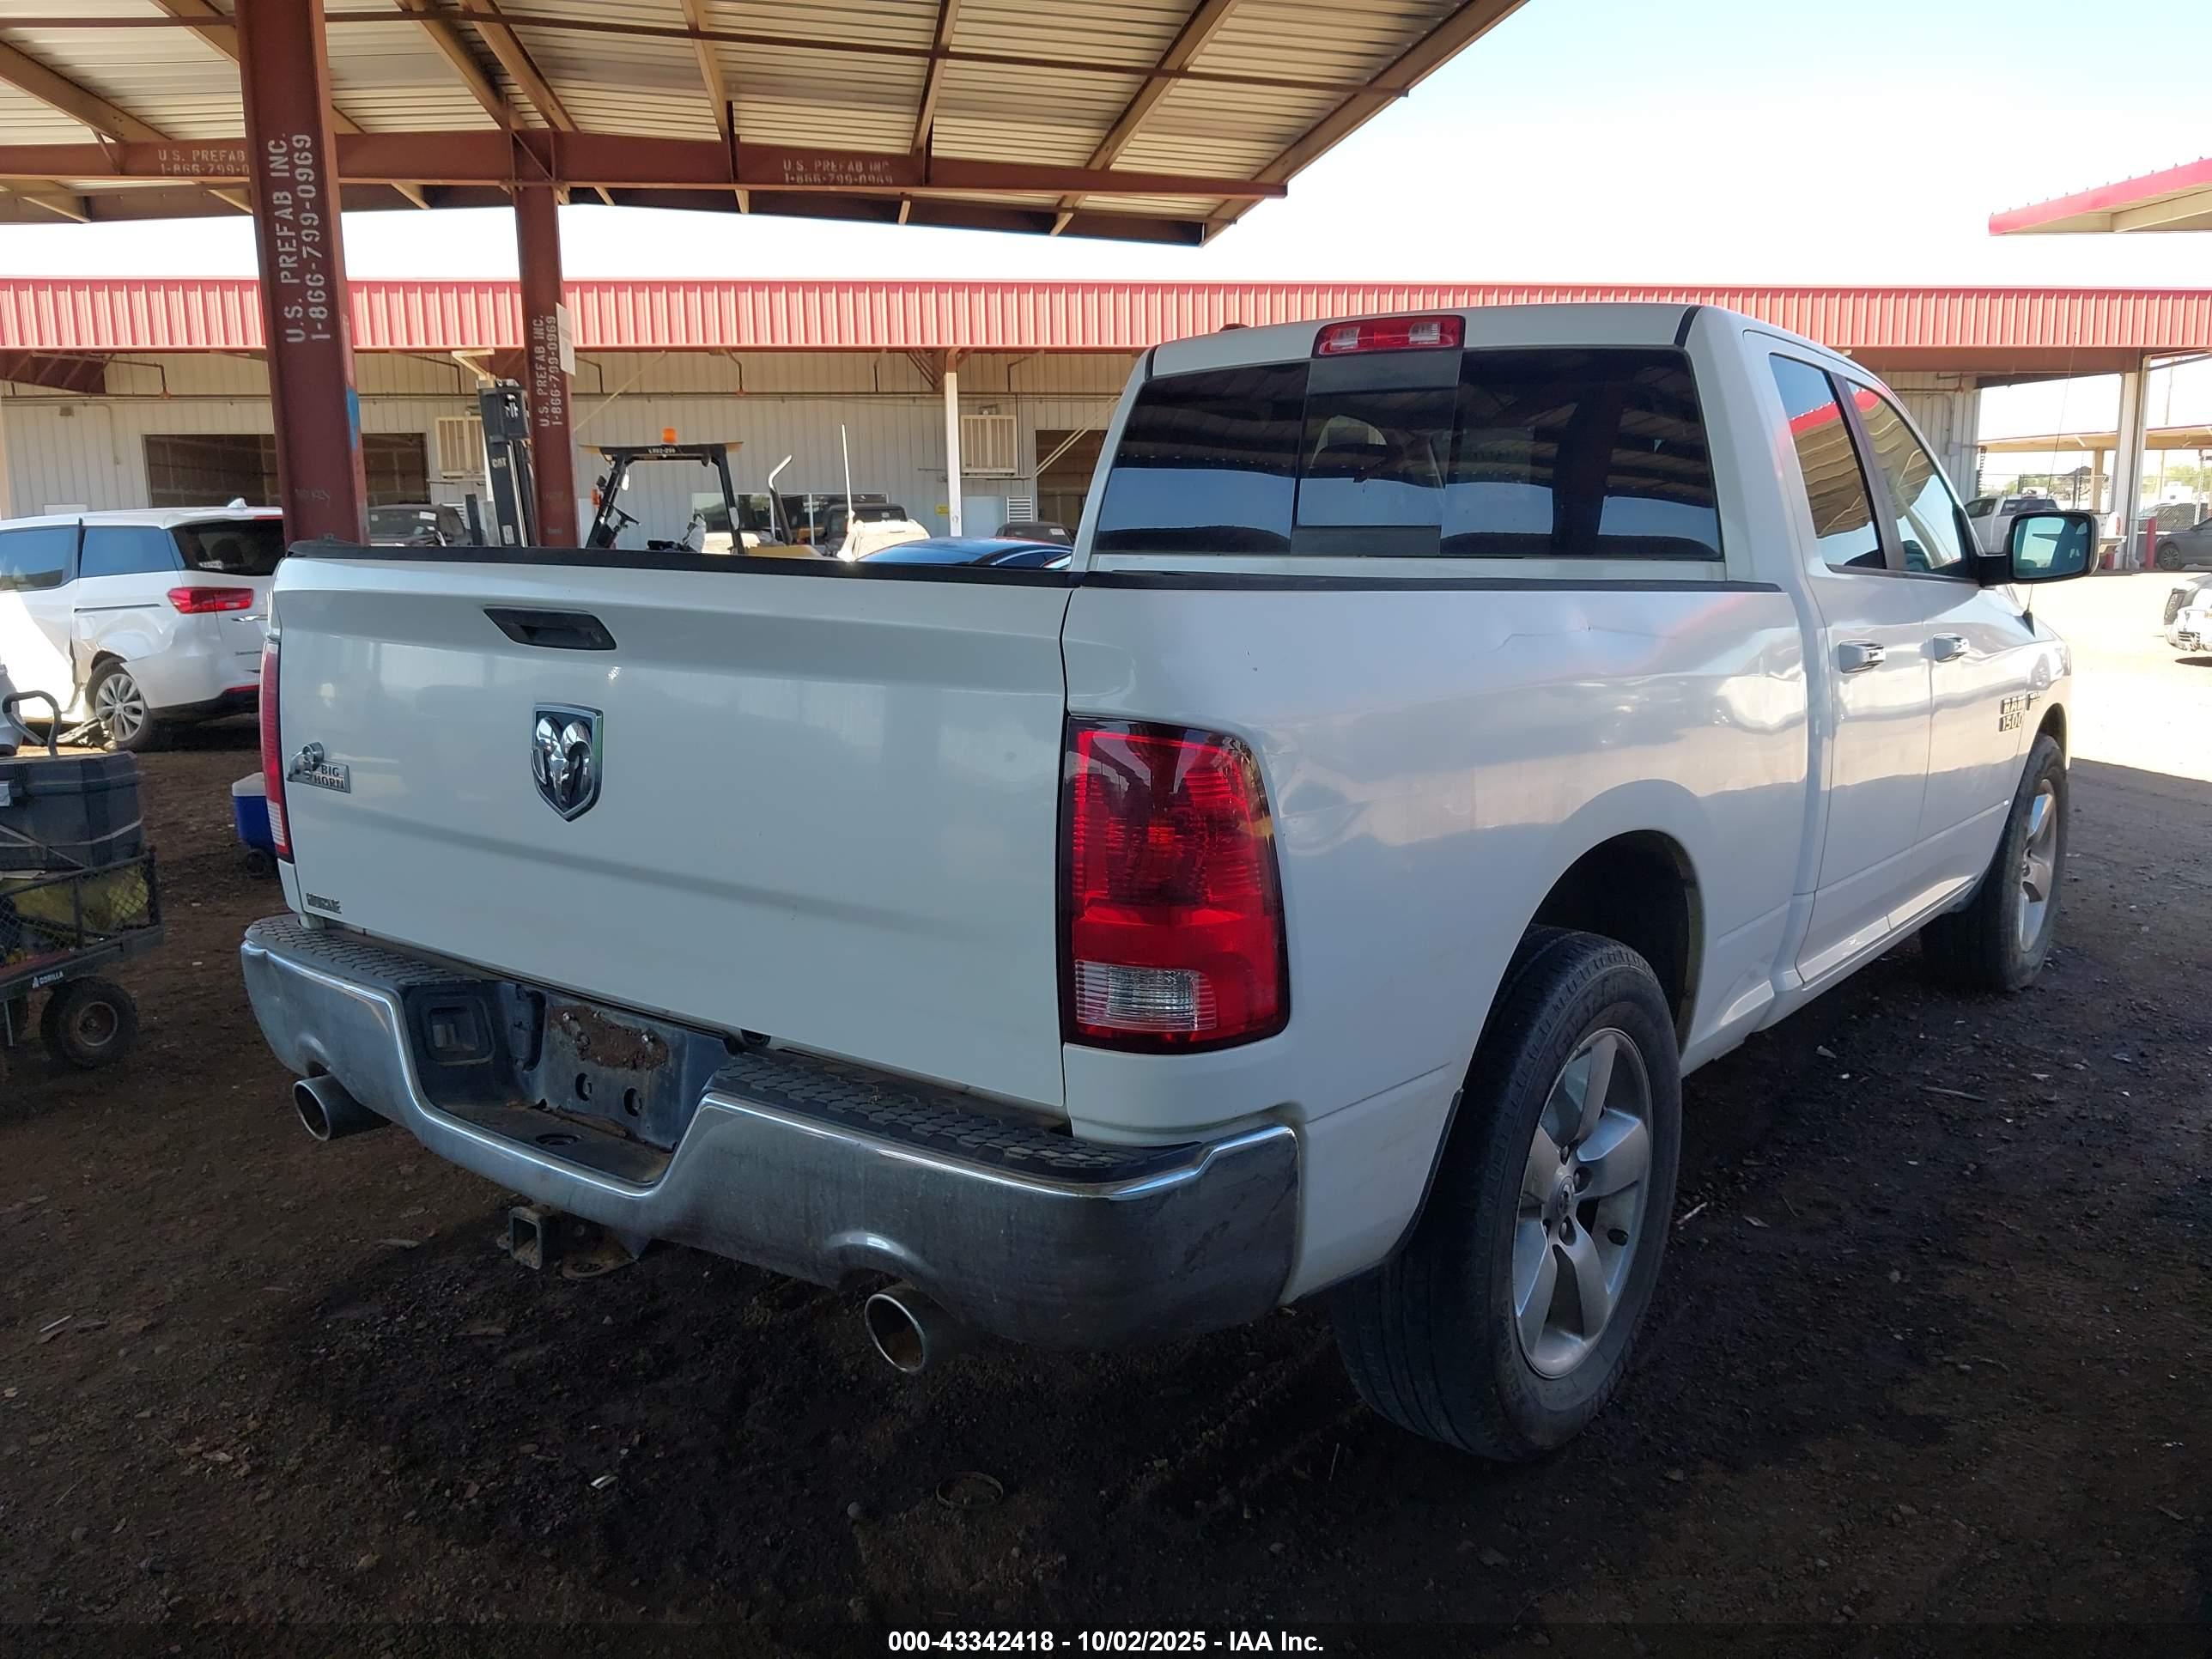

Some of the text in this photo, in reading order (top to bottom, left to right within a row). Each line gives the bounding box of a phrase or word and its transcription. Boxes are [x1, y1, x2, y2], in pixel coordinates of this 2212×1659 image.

[191, 149, 246, 162] PREFAB
[268, 132, 306, 343] U.S. PREFAB INC.
[292, 134, 331, 340] 1-866-799-0969
[532, 314, 550, 427] U.S. PREFAB INC.
[545, 315, 563, 426] 1-866-799-0969
[491, 457, 507, 469] CAT
[313, 775, 344, 789] HORN
[320, 763, 340, 777] BIG
